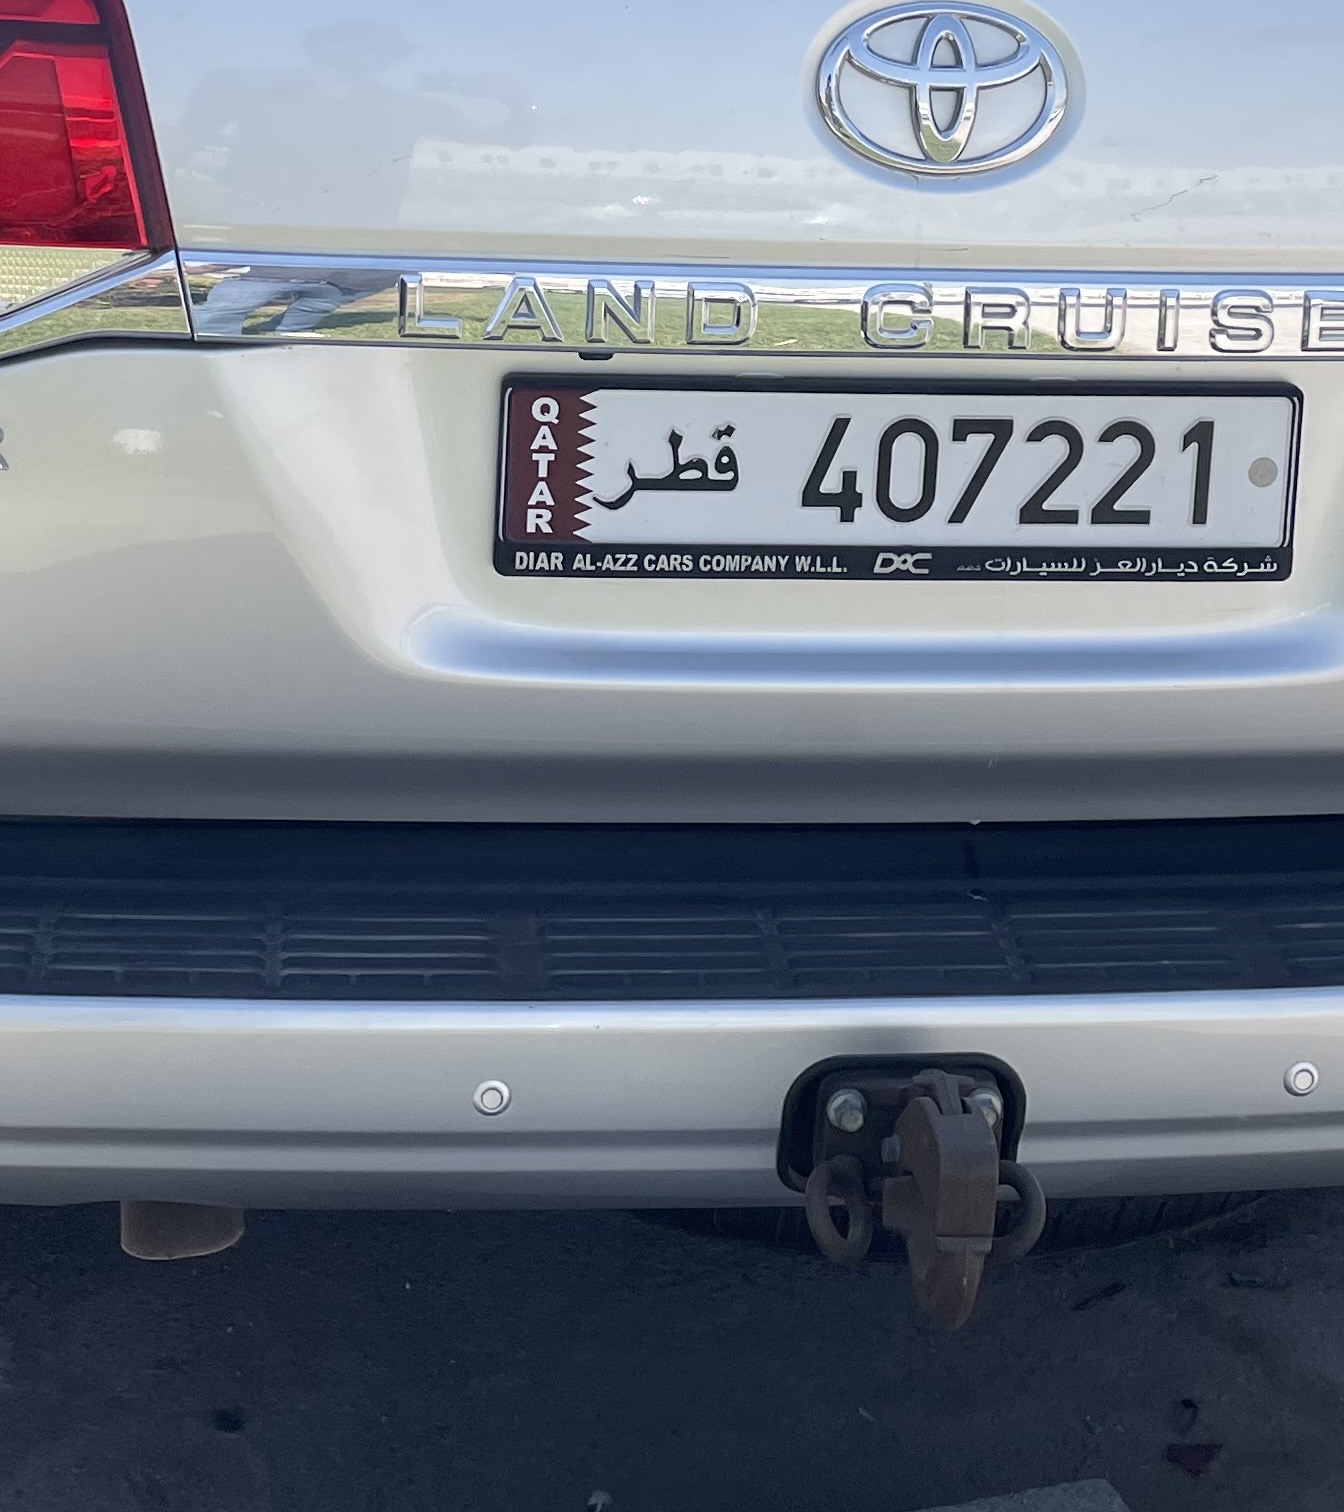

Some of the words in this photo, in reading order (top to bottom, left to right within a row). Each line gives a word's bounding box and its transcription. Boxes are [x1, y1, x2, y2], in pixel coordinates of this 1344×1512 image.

[394, 271, 762, 348] LAND
[525, 395, 560, 536] QATAR
[592, 424, 741, 510] قطر
[800, 416, 1217, 527] 407221
[514, 551, 564, 572] DIAR
[572, 552, 639, 572] AL-AZZ
[643, 553, 694, 573] CARS
[699, 553, 790, 574] COMPANY
[794, 555, 849, 575] W.L.L.
[984, 556, 1087, 576] للسيارات
[1203, 554, 1278, 576] شركة
